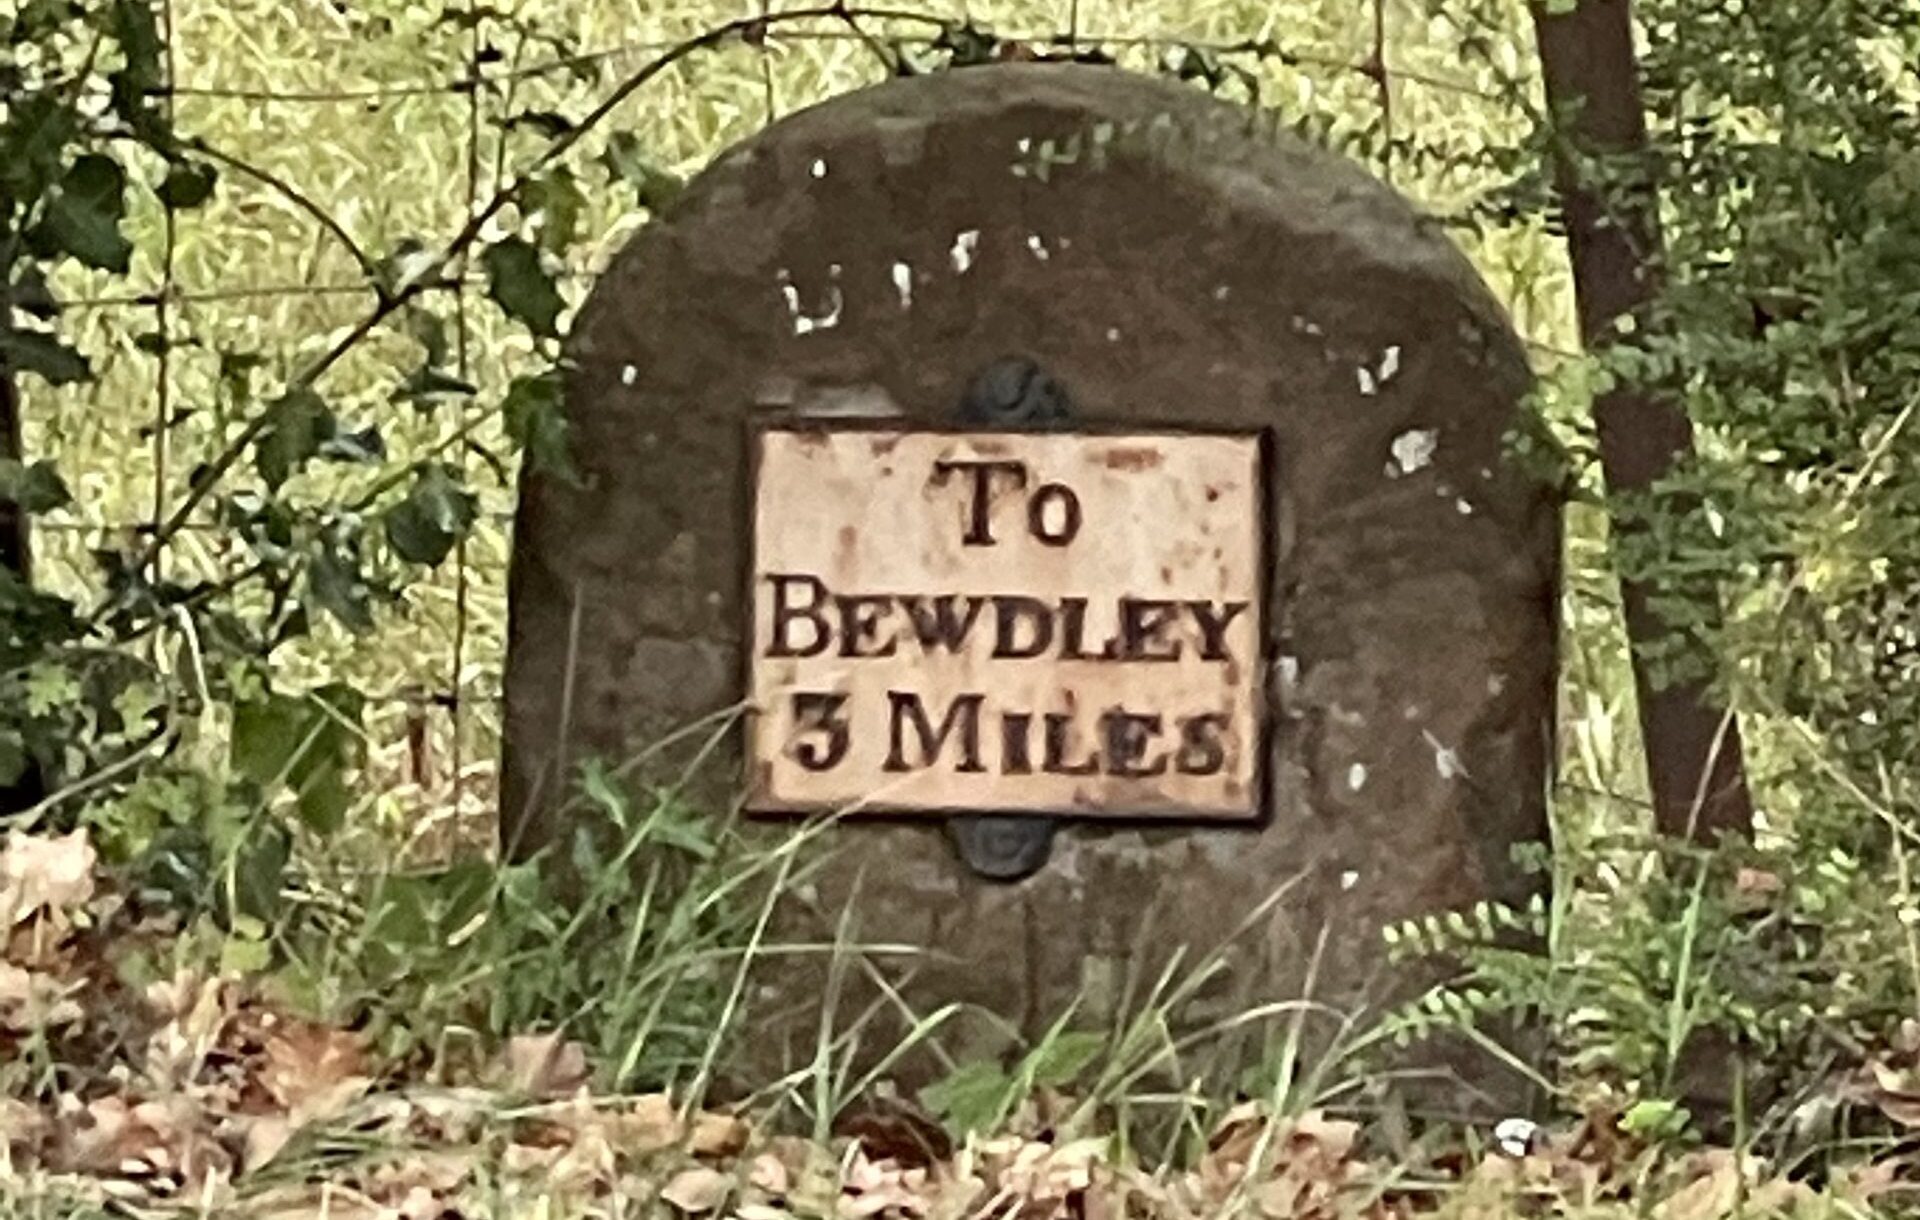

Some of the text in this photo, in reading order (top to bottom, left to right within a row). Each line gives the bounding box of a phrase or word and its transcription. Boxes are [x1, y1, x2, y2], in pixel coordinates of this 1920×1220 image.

[931, 459, 1083, 548] To
[763, 573, 1250, 662] BEWDLEY
[785, 689, 1231, 776] 3 MILES
